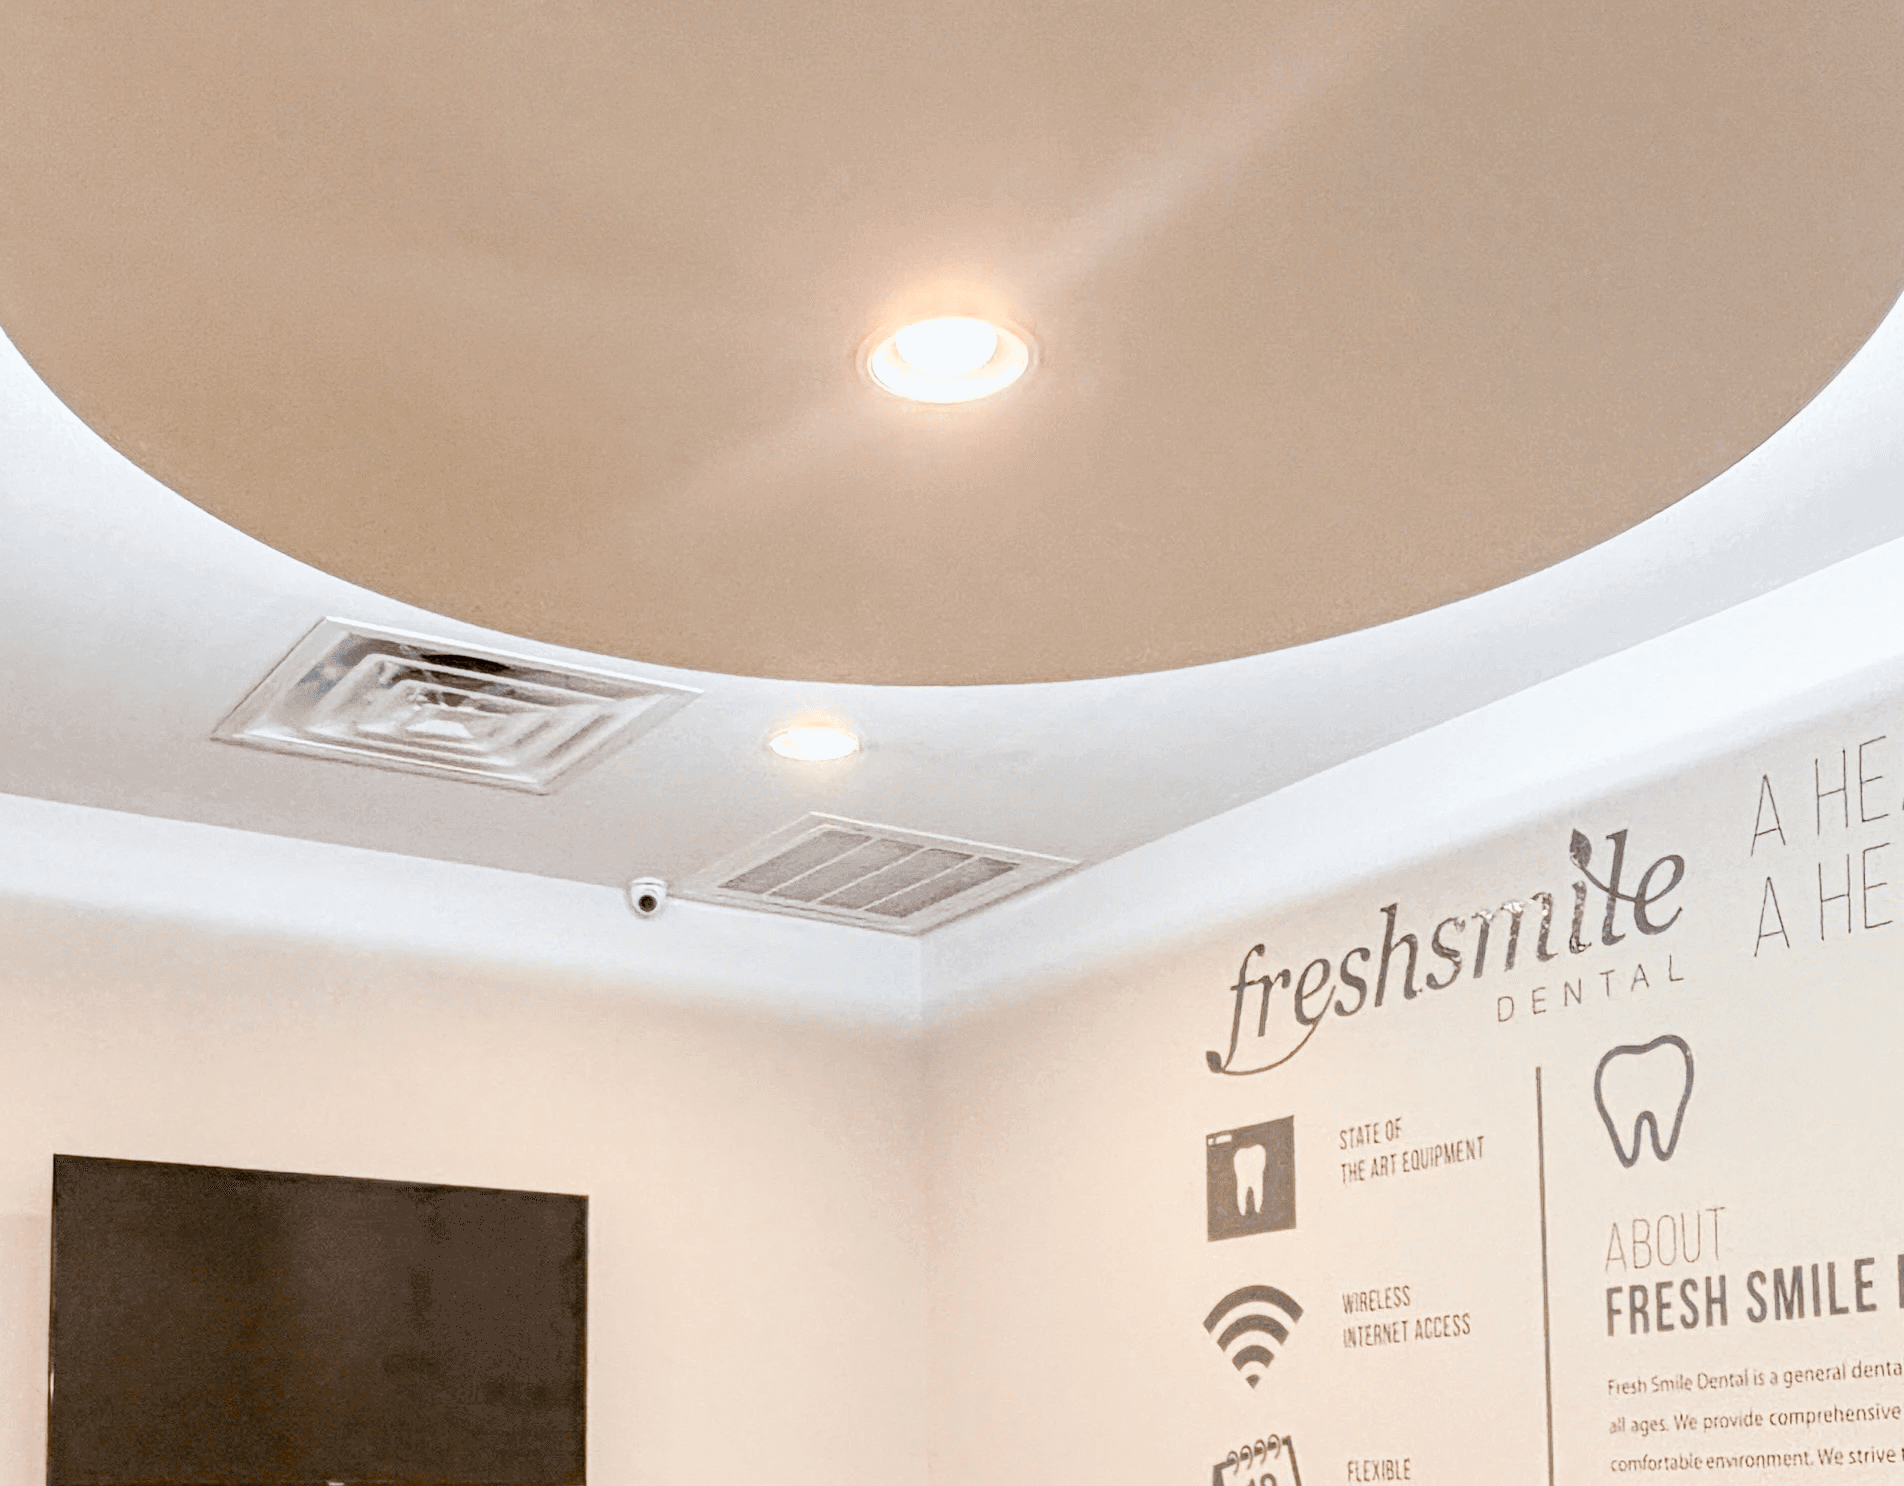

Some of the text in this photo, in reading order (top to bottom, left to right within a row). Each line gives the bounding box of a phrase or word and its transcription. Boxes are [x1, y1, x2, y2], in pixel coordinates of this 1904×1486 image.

[1750, 773, 1787, 857] A
[1753, 875, 1791, 958] A
[1496, 954, 1685, 1023] DENTAL
[1339, 1116, 1402, 1151] STATE OF
[1340, 1134, 1485, 1184] THE ART EQUIPMENT
[1604, 1205, 1727, 1272] ABOUT
[1341, 1284, 1411, 1315] WIRELESS
[1606, 1274, 1728, 1337] FRESH
[1746, 1257, 1878, 1324] SMILE
[1342, 1312, 1471, 1348] INTERNET ACCESS
[1607, 1378, 1648, 1395] Fresh
[1650, 1373, 1693, 1394] Smile
[1696, 1368, 1749, 1391] Dental
[1753, 1371, 1765, 1387] is
[1769, 1371, 1779, 1386] a
[1783, 1363, 1847, 1390] general
[1673, 1413, 1698, 1431] We
[1703, 1410, 1764, 1431] provide
[1768, 1405, 1902, 1428] comprehensive
[1346, 1457, 1411, 1483] FLEXIBLE
[1610, 1452, 1704, 1473] comfortable
[1705, 1450, 1816, 1470] environment.
[1817, 1447, 1844, 1466] We
[1848, 1443, 1897, 1465] strive
